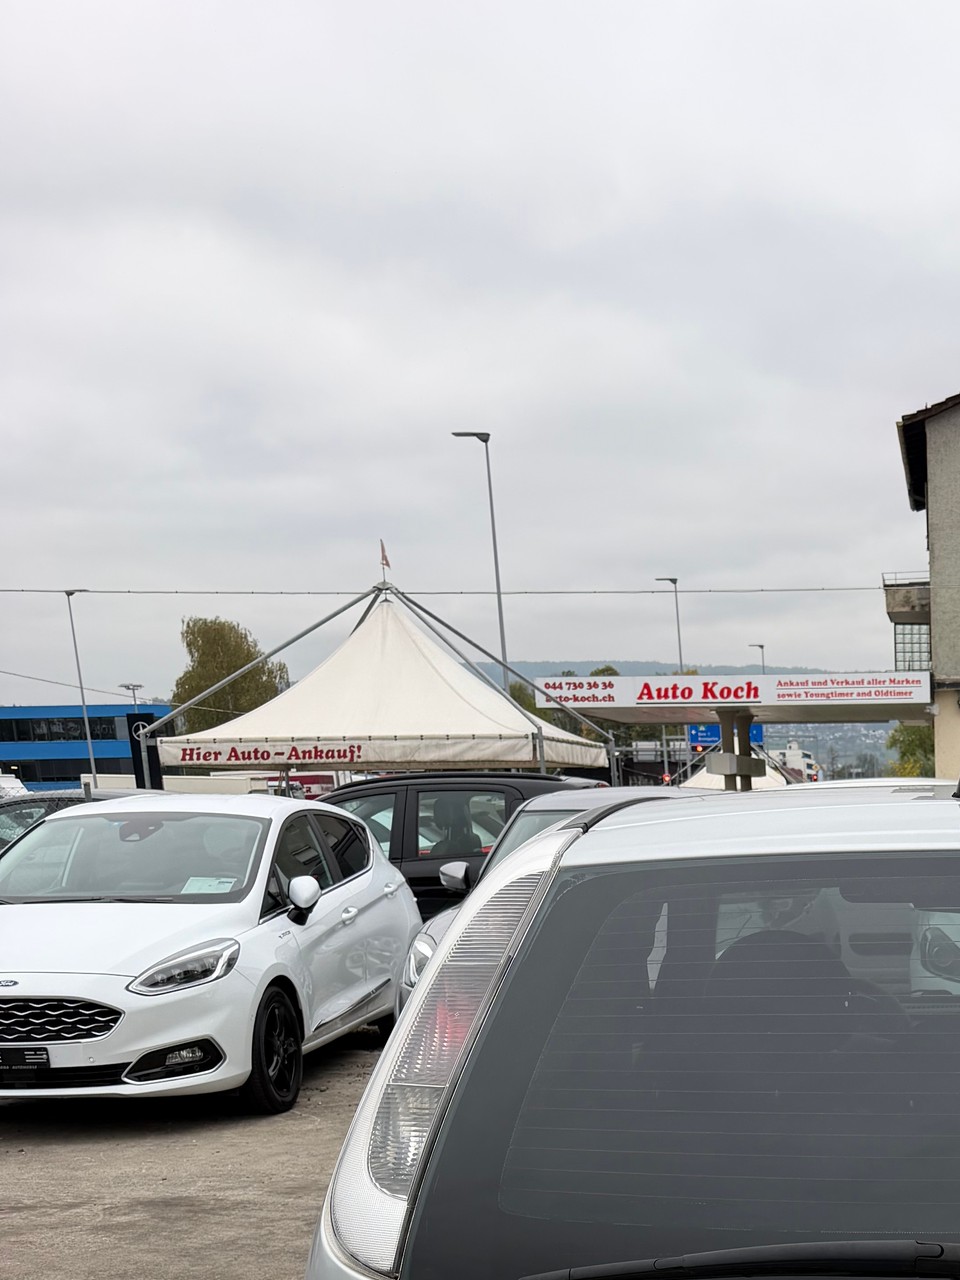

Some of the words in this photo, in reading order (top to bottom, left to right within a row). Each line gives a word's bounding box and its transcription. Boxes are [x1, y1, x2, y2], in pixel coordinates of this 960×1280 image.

[544, 682, 563, 690] 044
[565, 682, 584, 690] 730
[586, 681, 600, 690] 36
[601, 681, 614, 690] 36
[776, 679, 809, 688] Ankauf
[811, 679, 828, 687] und
[830, 679, 865, 687] Verkauf
[866, 678, 886, 686] aller
[889, 678, 921, 686] Marken
[637, 682, 693, 700] Auto
[701, 681, 759, 700] Koch
[777, 691, 801, 699] sowie
[804, 691, 853, 699] Youngtimer
[874, 690, 913, 698] Oldtimer
[545, 694, 615, 703] ato-koch.ch
[180, 747, 222, 762] Hier
